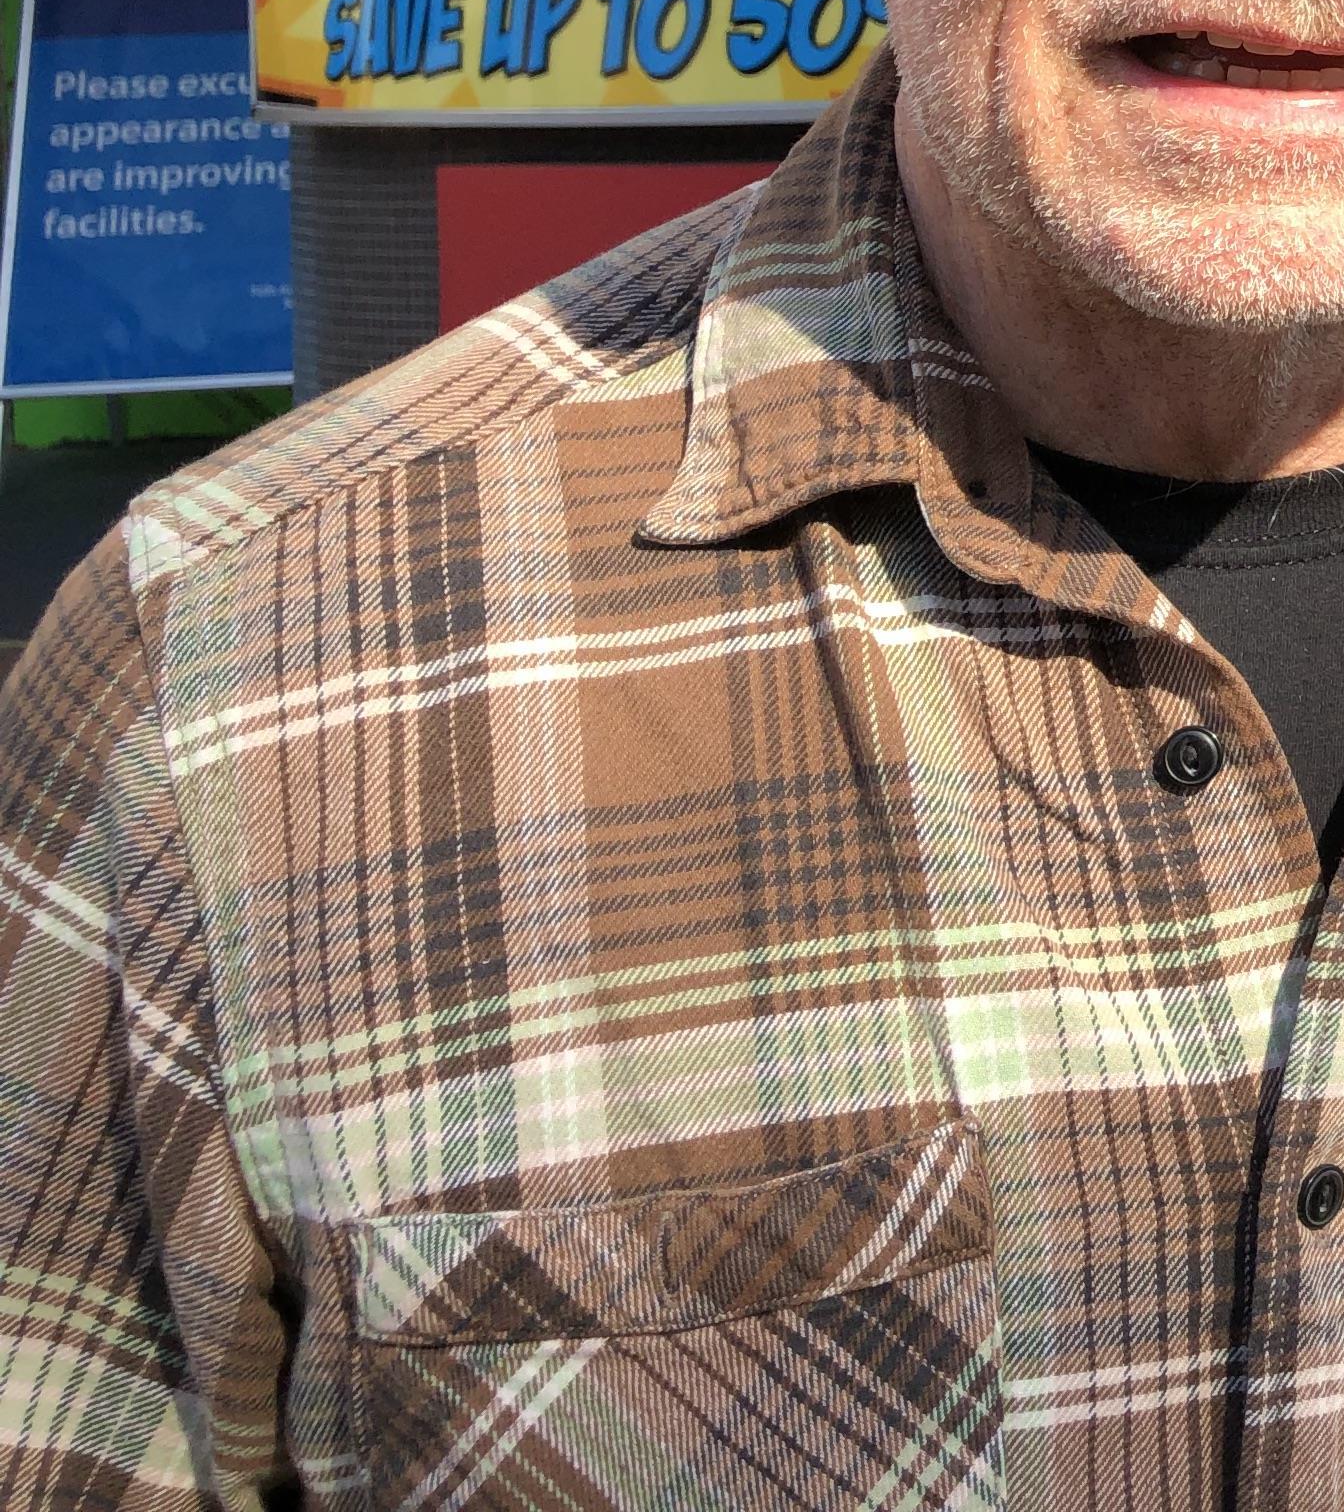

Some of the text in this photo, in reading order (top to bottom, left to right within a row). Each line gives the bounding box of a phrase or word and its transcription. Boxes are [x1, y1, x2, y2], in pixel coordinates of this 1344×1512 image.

[54, 70, 169, 101] Please
[50, 116, 261, 152] appearance
[47, 167, 105, 193] are
[43, 205, 206, 239] facilities.
